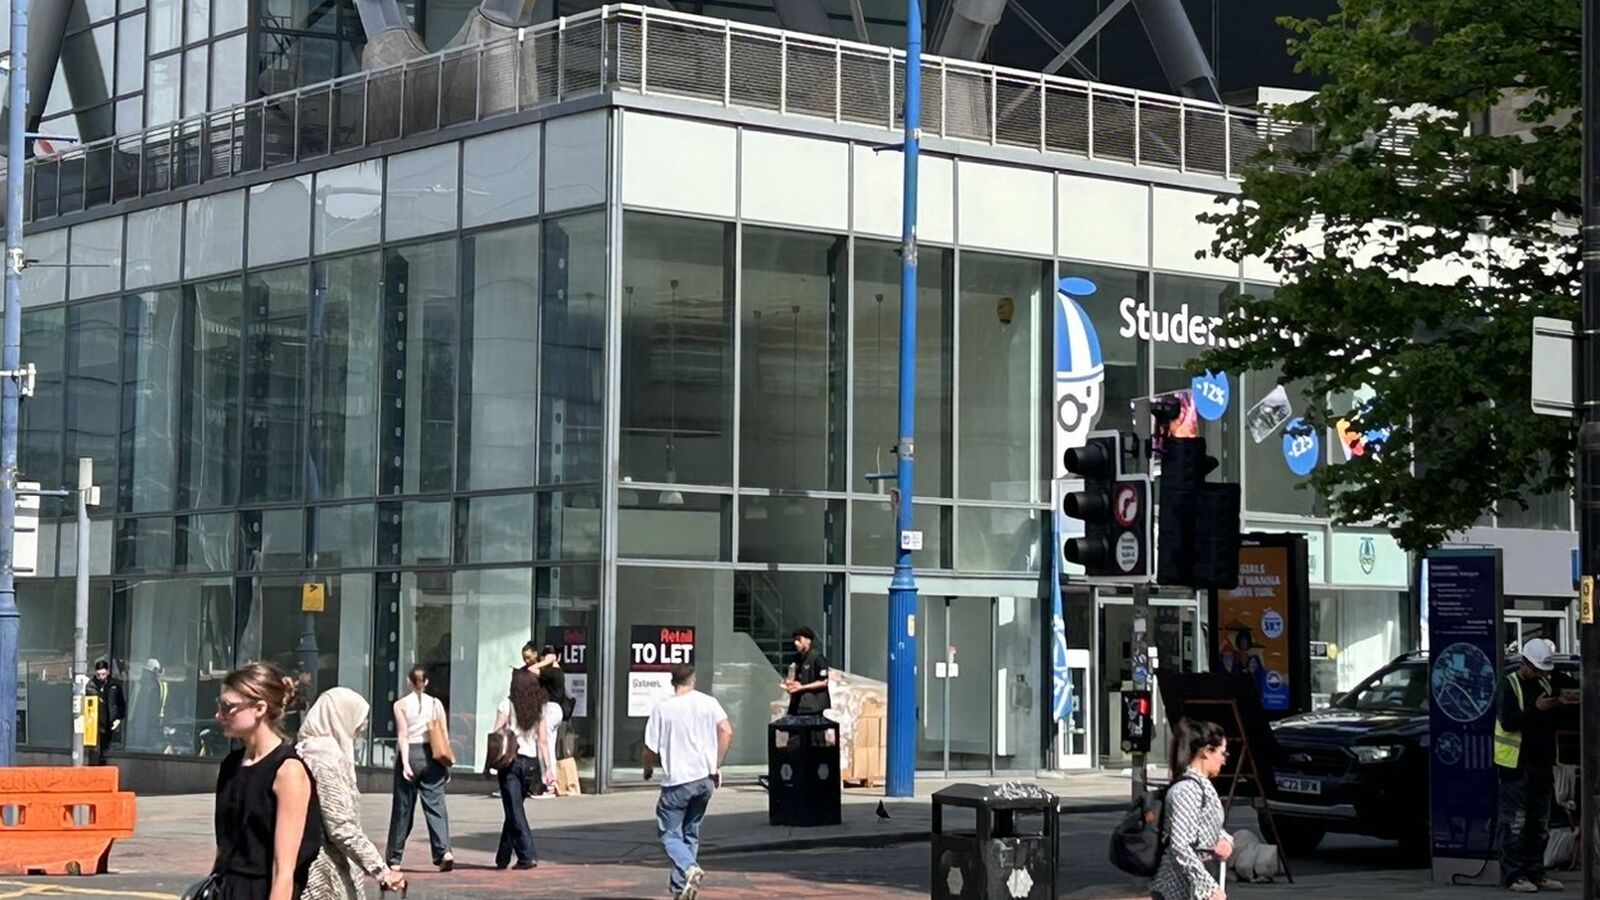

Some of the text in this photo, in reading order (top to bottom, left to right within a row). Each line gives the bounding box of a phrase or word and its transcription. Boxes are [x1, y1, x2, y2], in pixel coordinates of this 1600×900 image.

[660, 627, 693, 643] Retail
[563, 644, 587, 664] LET
[631, 642, 693, 664] TO LET
